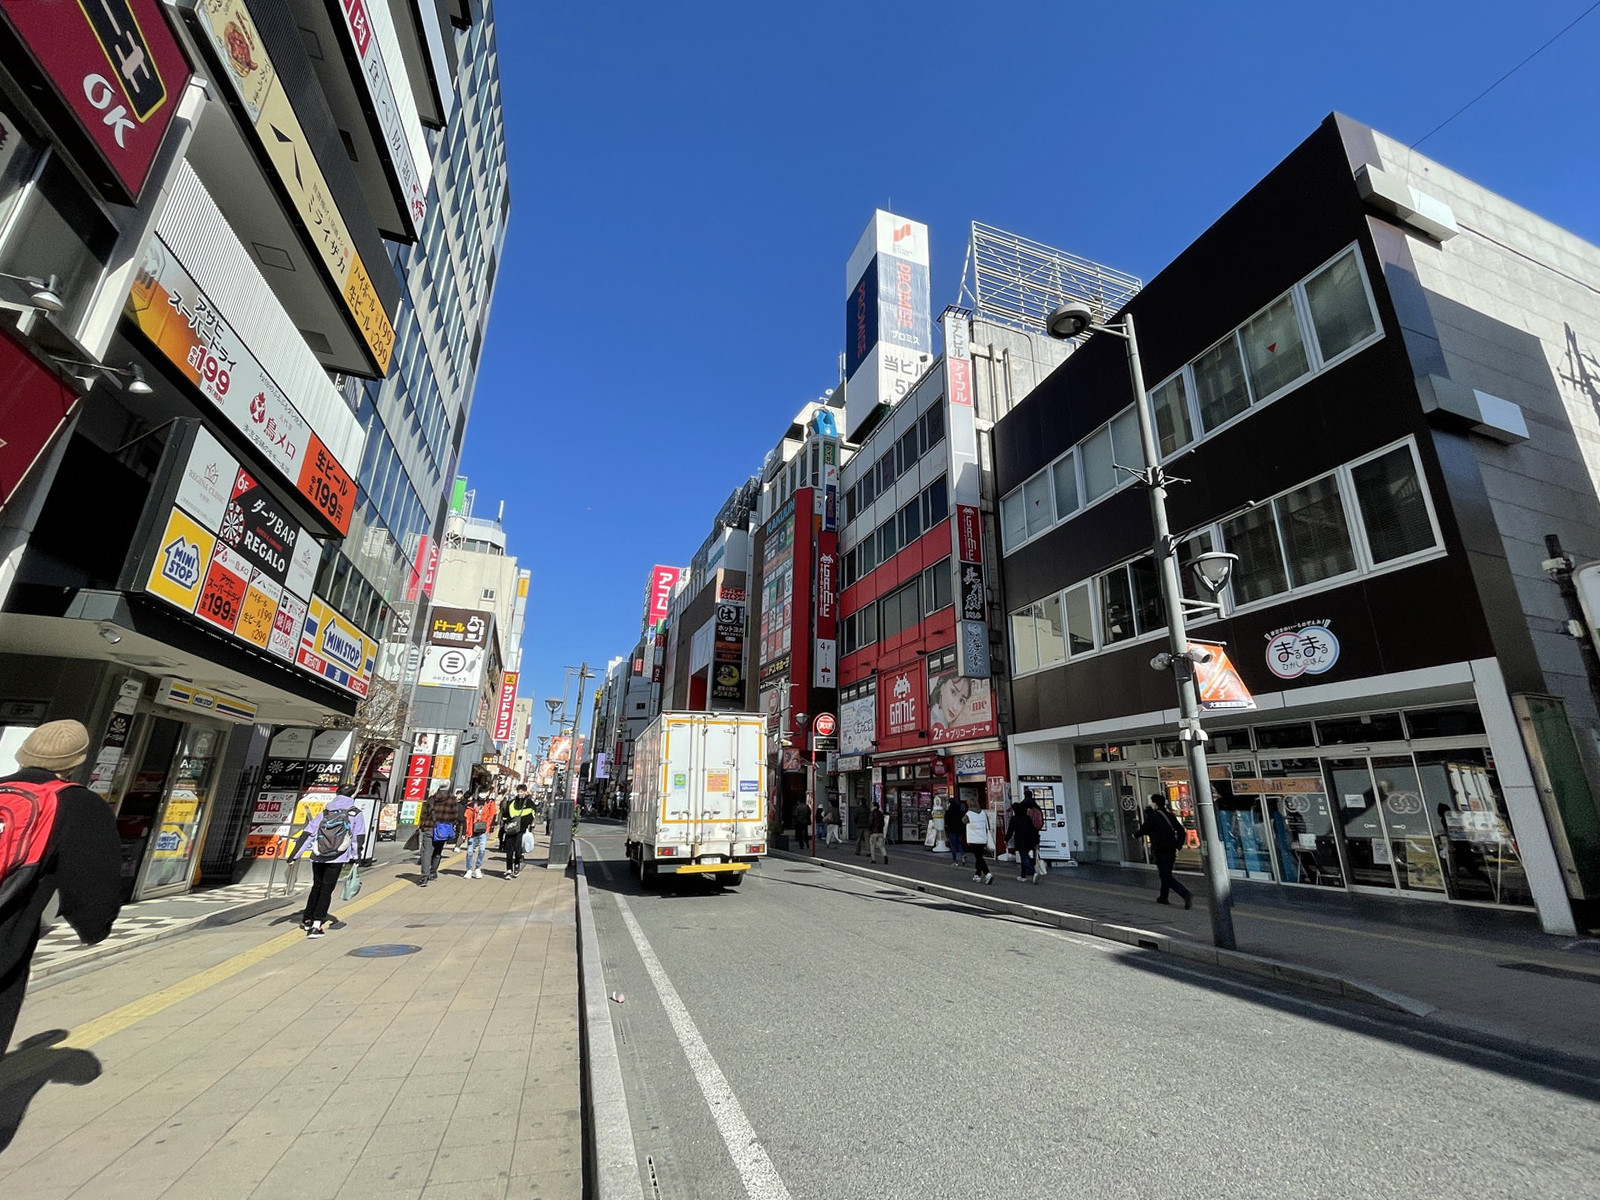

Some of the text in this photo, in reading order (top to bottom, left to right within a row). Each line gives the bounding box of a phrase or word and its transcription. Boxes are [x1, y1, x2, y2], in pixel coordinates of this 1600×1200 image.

[83, 73, 136, 149] OK
[308, 193, 346, 274] ミライザカ
[353, 265, 376, 312] ハイボール
[897, 262, 912, 329] PROMISE
[195, 296, 225, 339] アサヒ
[348, 285, 371, 332] 生ビール
[857, 281, 867, 359] PROMISE
[169, 290, 237, 373] スーパードライ
[891, 330, 921, 345] プロミス
[194, 347, 231, 396] 199
[884, 354, 930, 377] 当ビル
[955, 361, 967, 403] アイフル
[263, 416, 297, 461] 鳥メロ
[237, 474, 250, 493] 6F
[315, 449, 348, 497] 生ビール
[314, 477, 339, 517] 199
[251, 499, 296, 547] ダーツBAR
[965, 515, 977, 561] GAME
[173, 548, 196, 566] MINI
[244, 530, 287, 573] REGALO
[168, 560, 194, 582] STOP
[219, 573, 235, 589] アサヒ
[206, 578, 241, 604] スーパードライ
[208, 592, 231, 618] 199
[656, 572, 674, 610] アコム
[823, 564, 834, 617] GAME
[243, 612, 263, 628] 生ビール
[274, 610, 294, 635] 焼肉
[433, 619, 465, 632] ドトール
[820, 642, 831, 651] 4F
[1274, 635, 1329, 663] まるまる
[820, 674, 831, 684] 1F
[1281, 656, 1326, 671] ひがしにほん
[496, 685, 514, 738] サンドラッグ
[889, 697, 916, 726] GAME
[971, 700, 988, 712] me
[933, 728, 943, 741] 2F
[950, 725, 984, 739] プリコーナー
[409, 757, 426, 796] カラオケ
[257, 802, 280, 811] 焼肉
